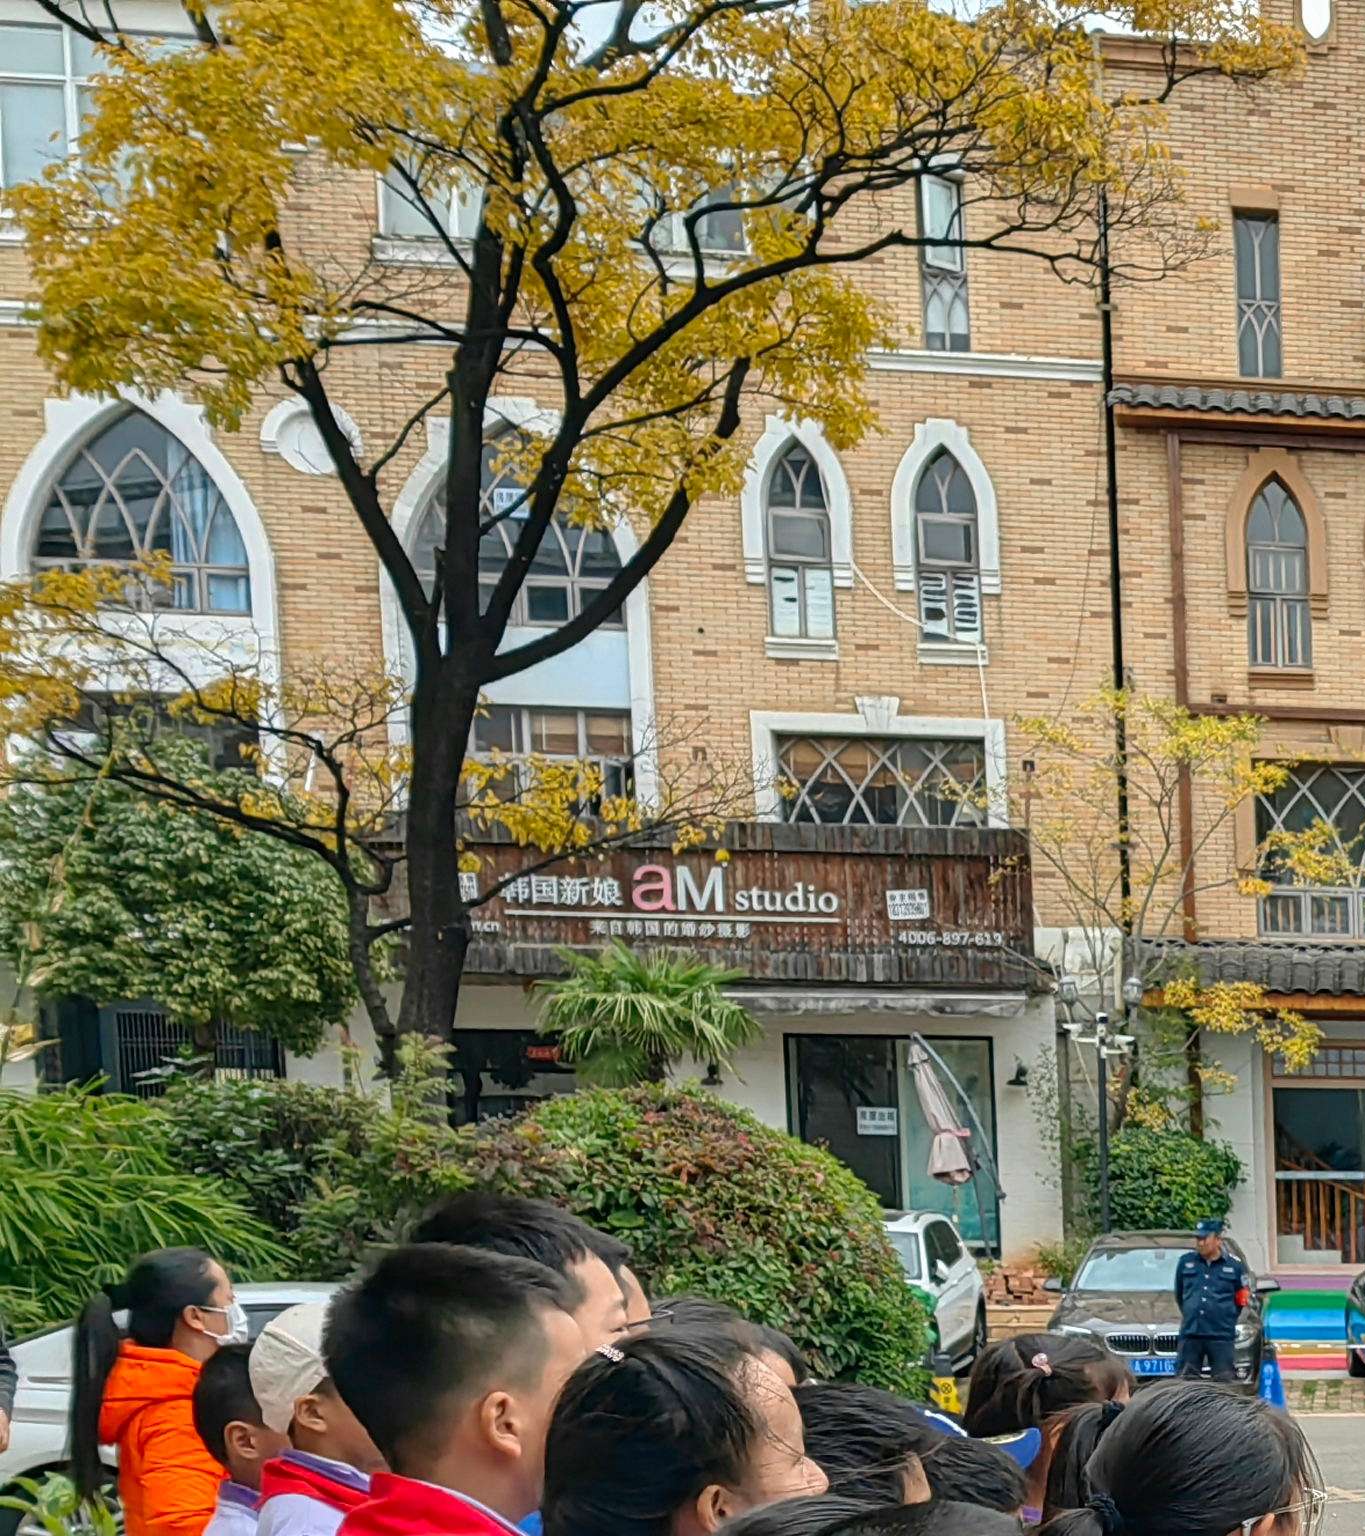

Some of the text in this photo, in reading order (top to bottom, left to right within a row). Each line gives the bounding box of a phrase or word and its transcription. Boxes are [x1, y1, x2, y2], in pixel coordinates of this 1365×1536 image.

[735, 883, 839, 913] studio
[591, 920, 750, 939] 来自韩国的婚纱摄影
